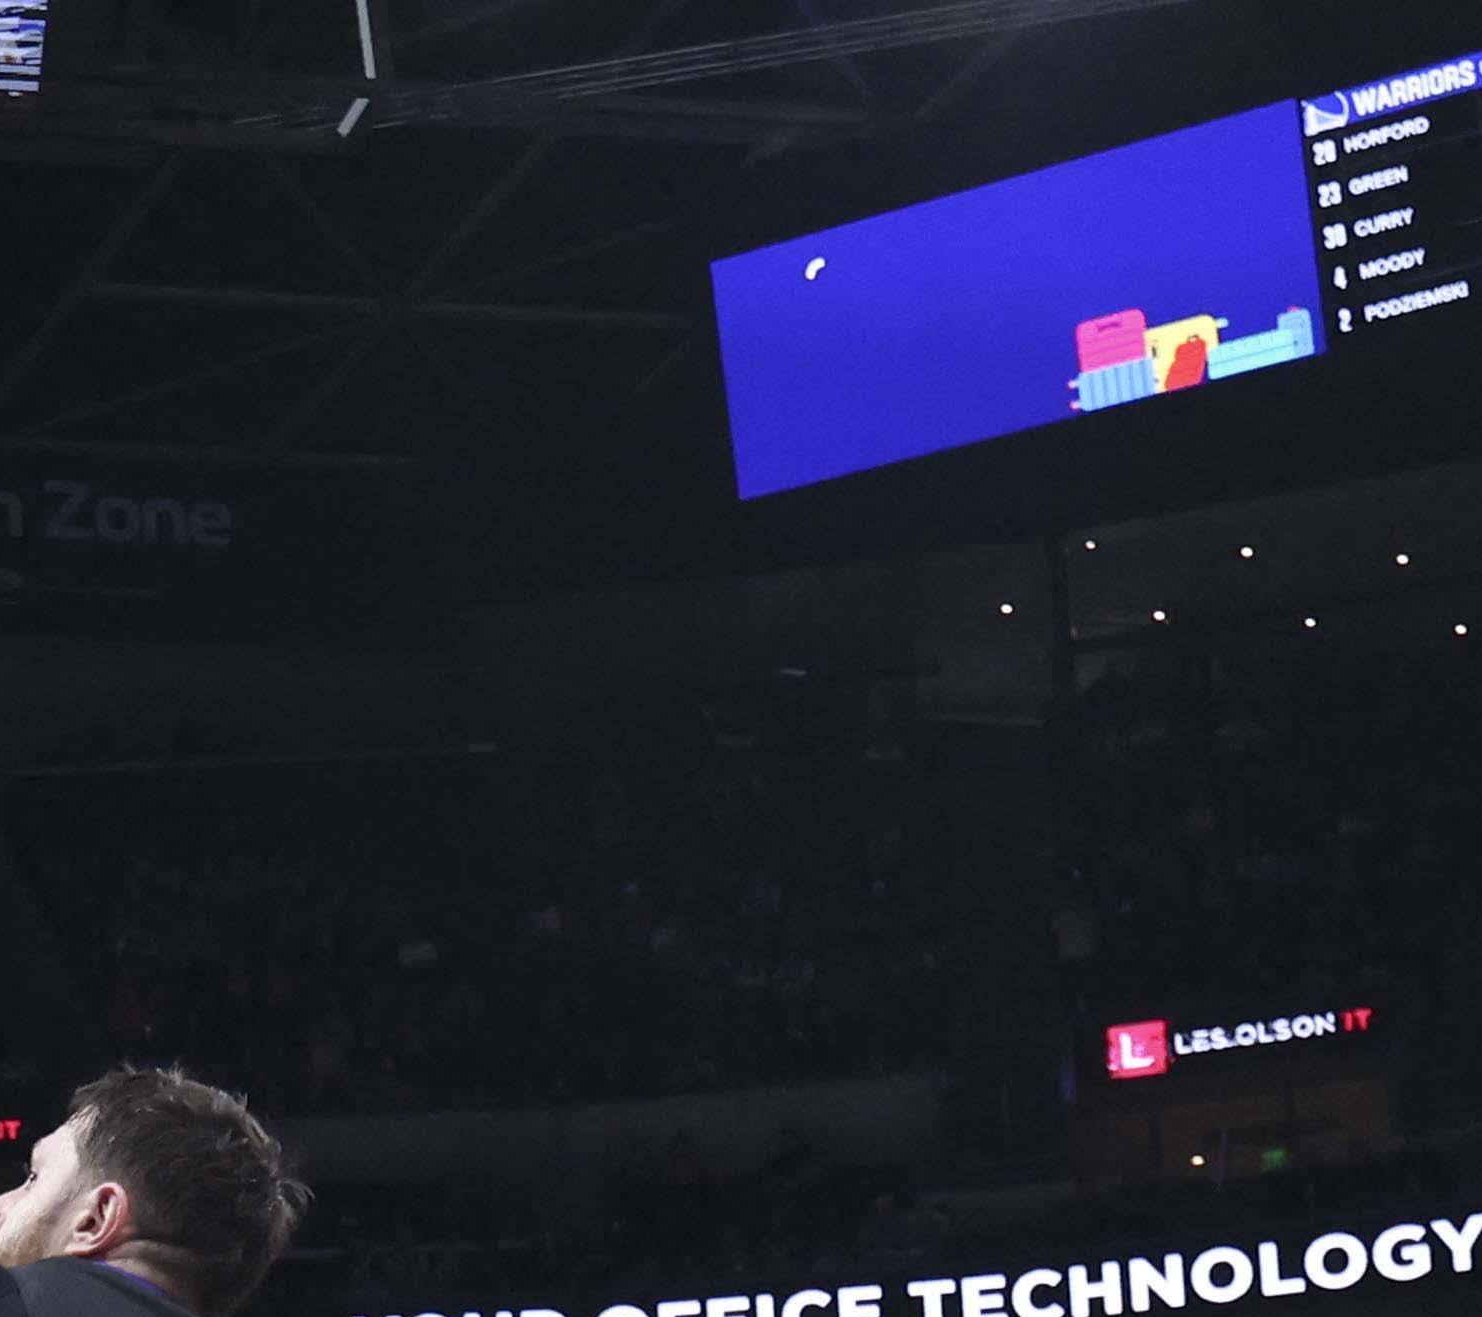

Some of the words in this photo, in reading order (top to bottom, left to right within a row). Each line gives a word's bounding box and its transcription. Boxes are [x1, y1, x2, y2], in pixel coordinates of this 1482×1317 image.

[1352, 60, 1476, 117] WARRIORS
[1341, 112, 1430, 154] HORFORD
[1348, 165, 1409, 195] GREEN
[1353, 207, 1414, 237] CURRY
[1333, 266, 1348, 290] 4
[1359, 248, 1425, 280] MOODY
[1338, 308, 1353, 333] 2
[1364, 281, 1469, 323] PODZIEMSKI
[44, 481, 233, 548] Zone
[1343, 1008, 1372, 1031] IT
